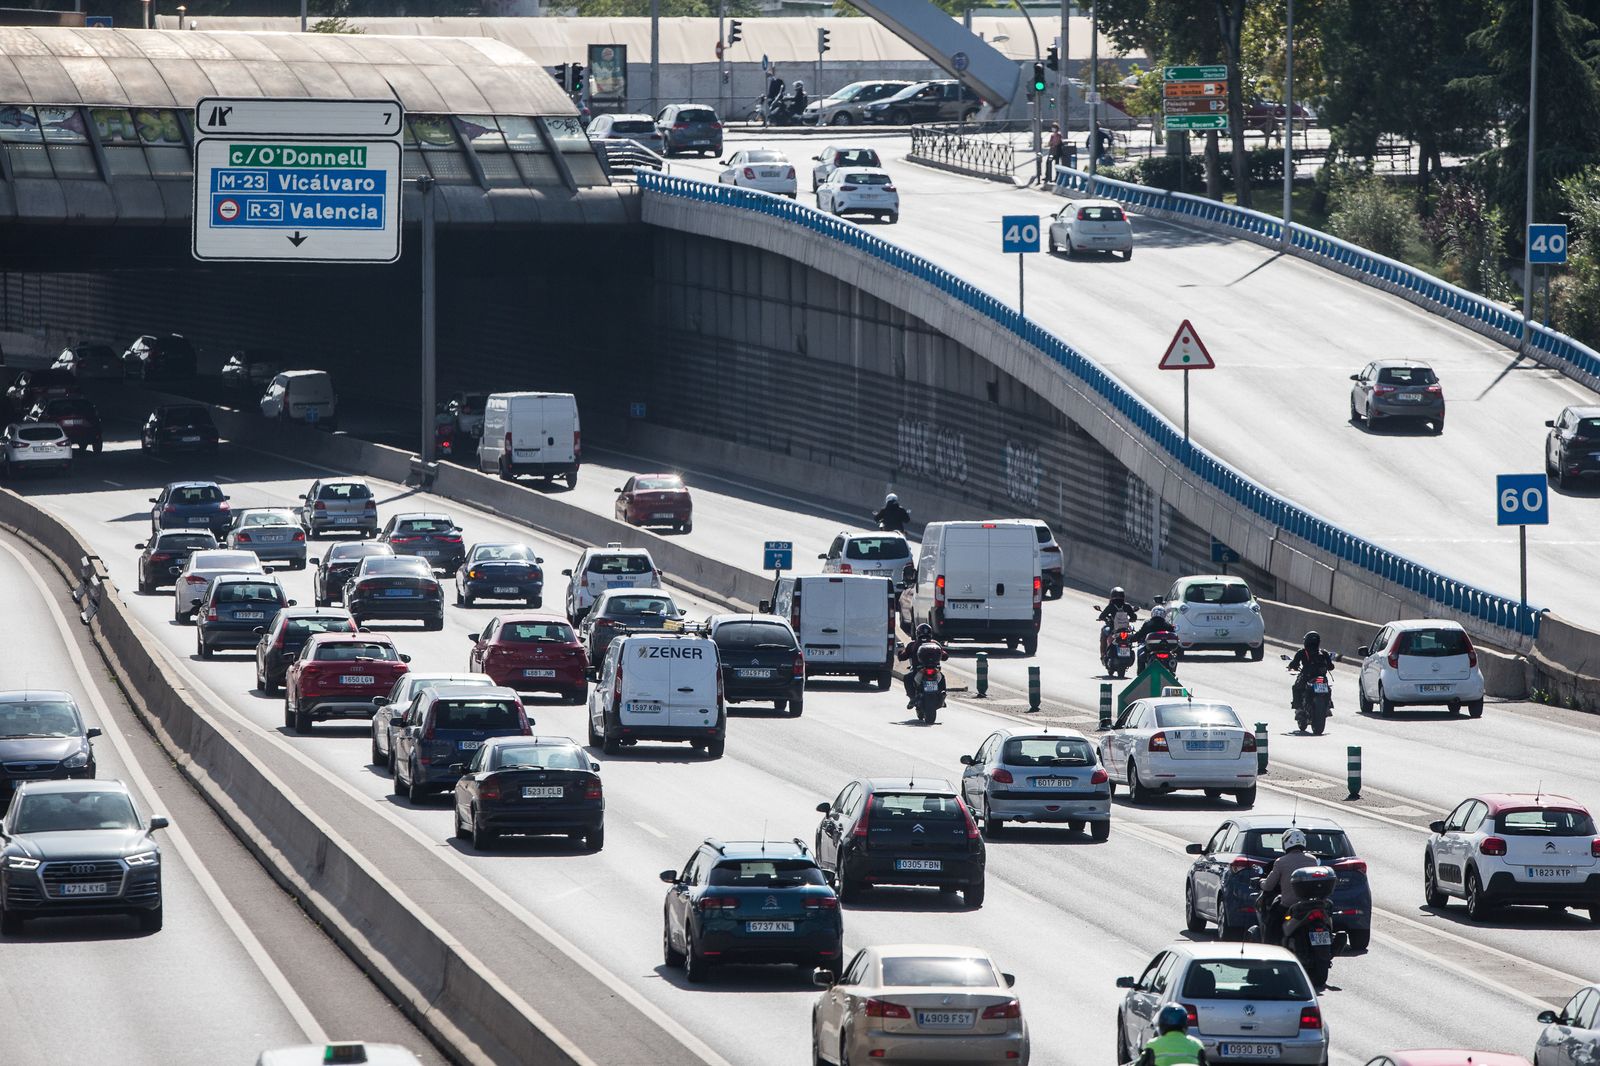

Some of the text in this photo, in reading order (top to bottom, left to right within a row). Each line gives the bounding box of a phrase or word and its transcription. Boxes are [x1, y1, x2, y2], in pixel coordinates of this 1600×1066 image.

[383, 113, 392, 125] 7
[221, 174, 375, 191] M-23 Vicálvaro
[250, 202, 378, 220] R-3 Valencia
[1005, 224, 1038, 244] 40
[1531, 234, 1565, 254] 40
[1500, 487, 1543, 513] 60
[775, 559, 782, 568] 6
[649, 646, 703, 660] ZENER
[632, 704, 649, 712] 1597
[527, 788, 546, 796] 5231
[1535, 868, 1571, 877] 1823 KTP
[89, 884, 106, 892] KYG
[751, 922, 792, 931] 6737 KNL
[925, 1014, 970, 1024] 4909 FSY
[1230, 1045, 1274, 1054] 0930 BXG
